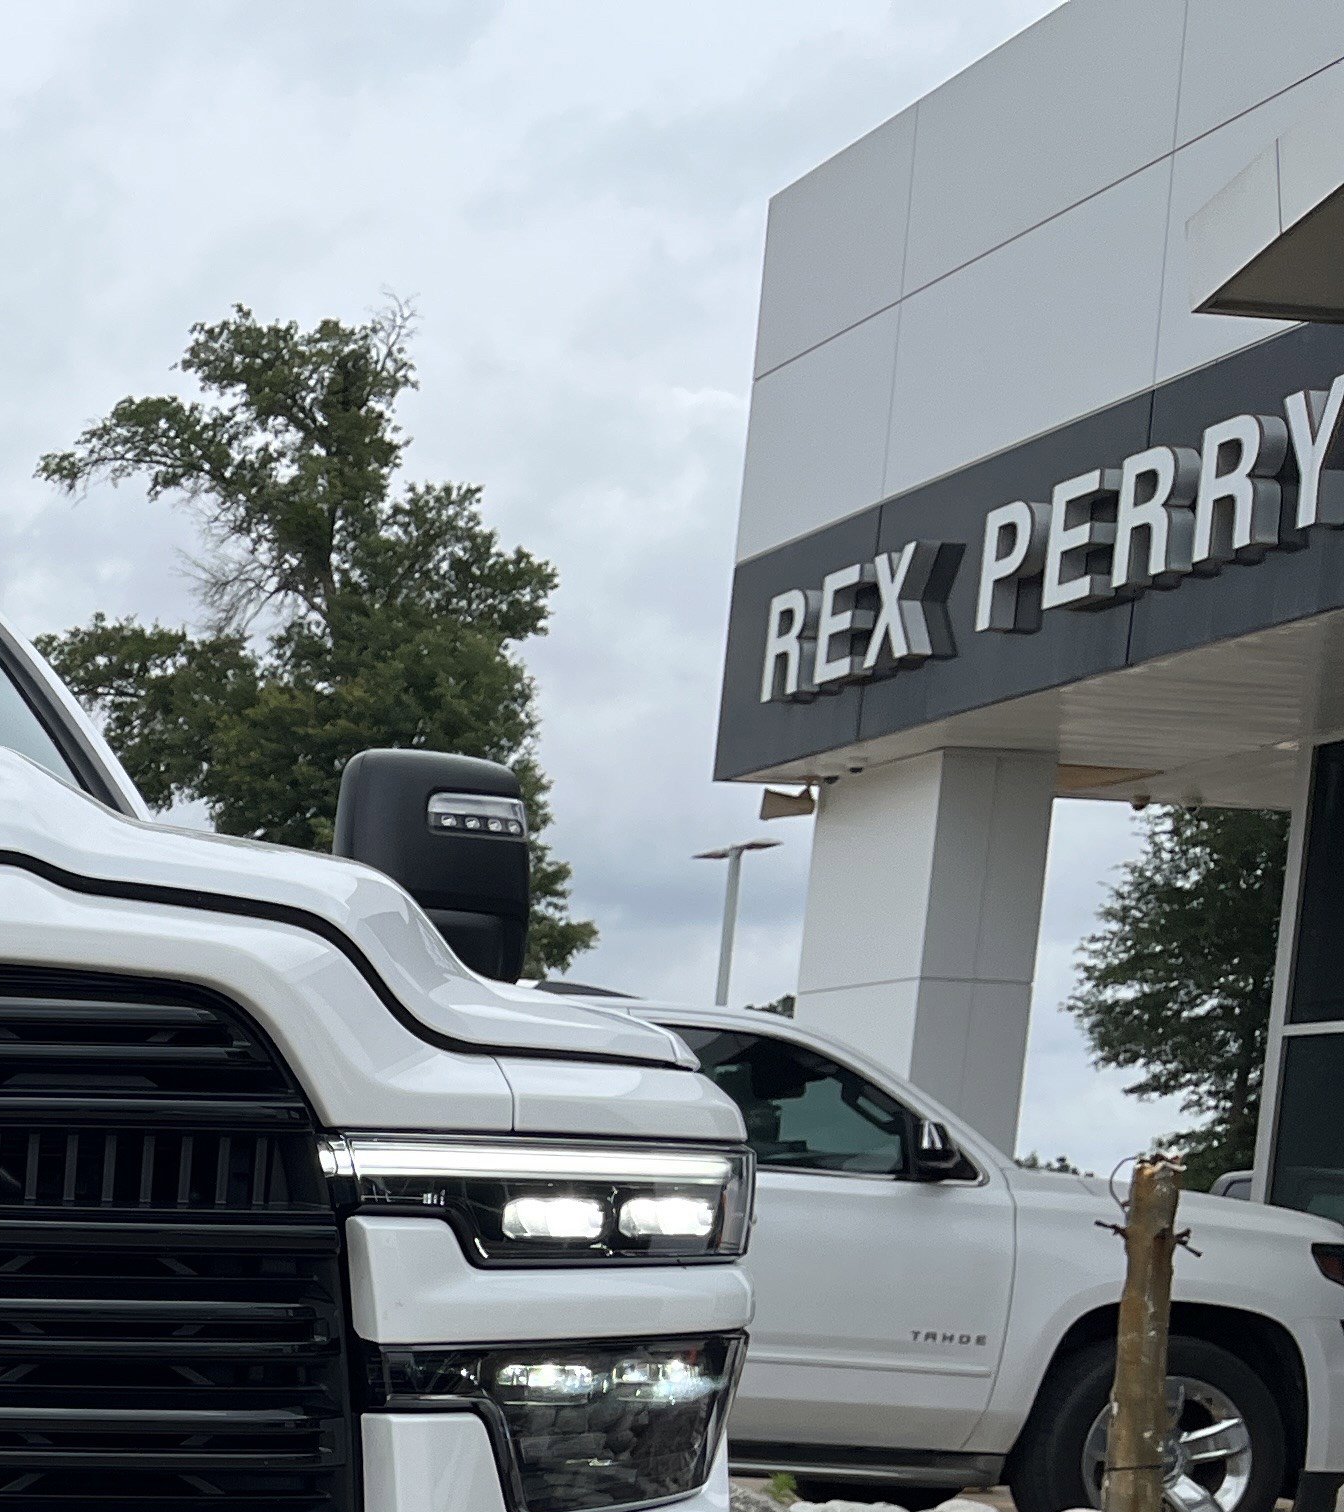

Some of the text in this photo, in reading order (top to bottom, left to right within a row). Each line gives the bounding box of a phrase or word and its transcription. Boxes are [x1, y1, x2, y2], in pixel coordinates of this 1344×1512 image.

[759, 373, 1344, 704] REX PERRY
[911, 1329, 987, 1346] TAHOE
